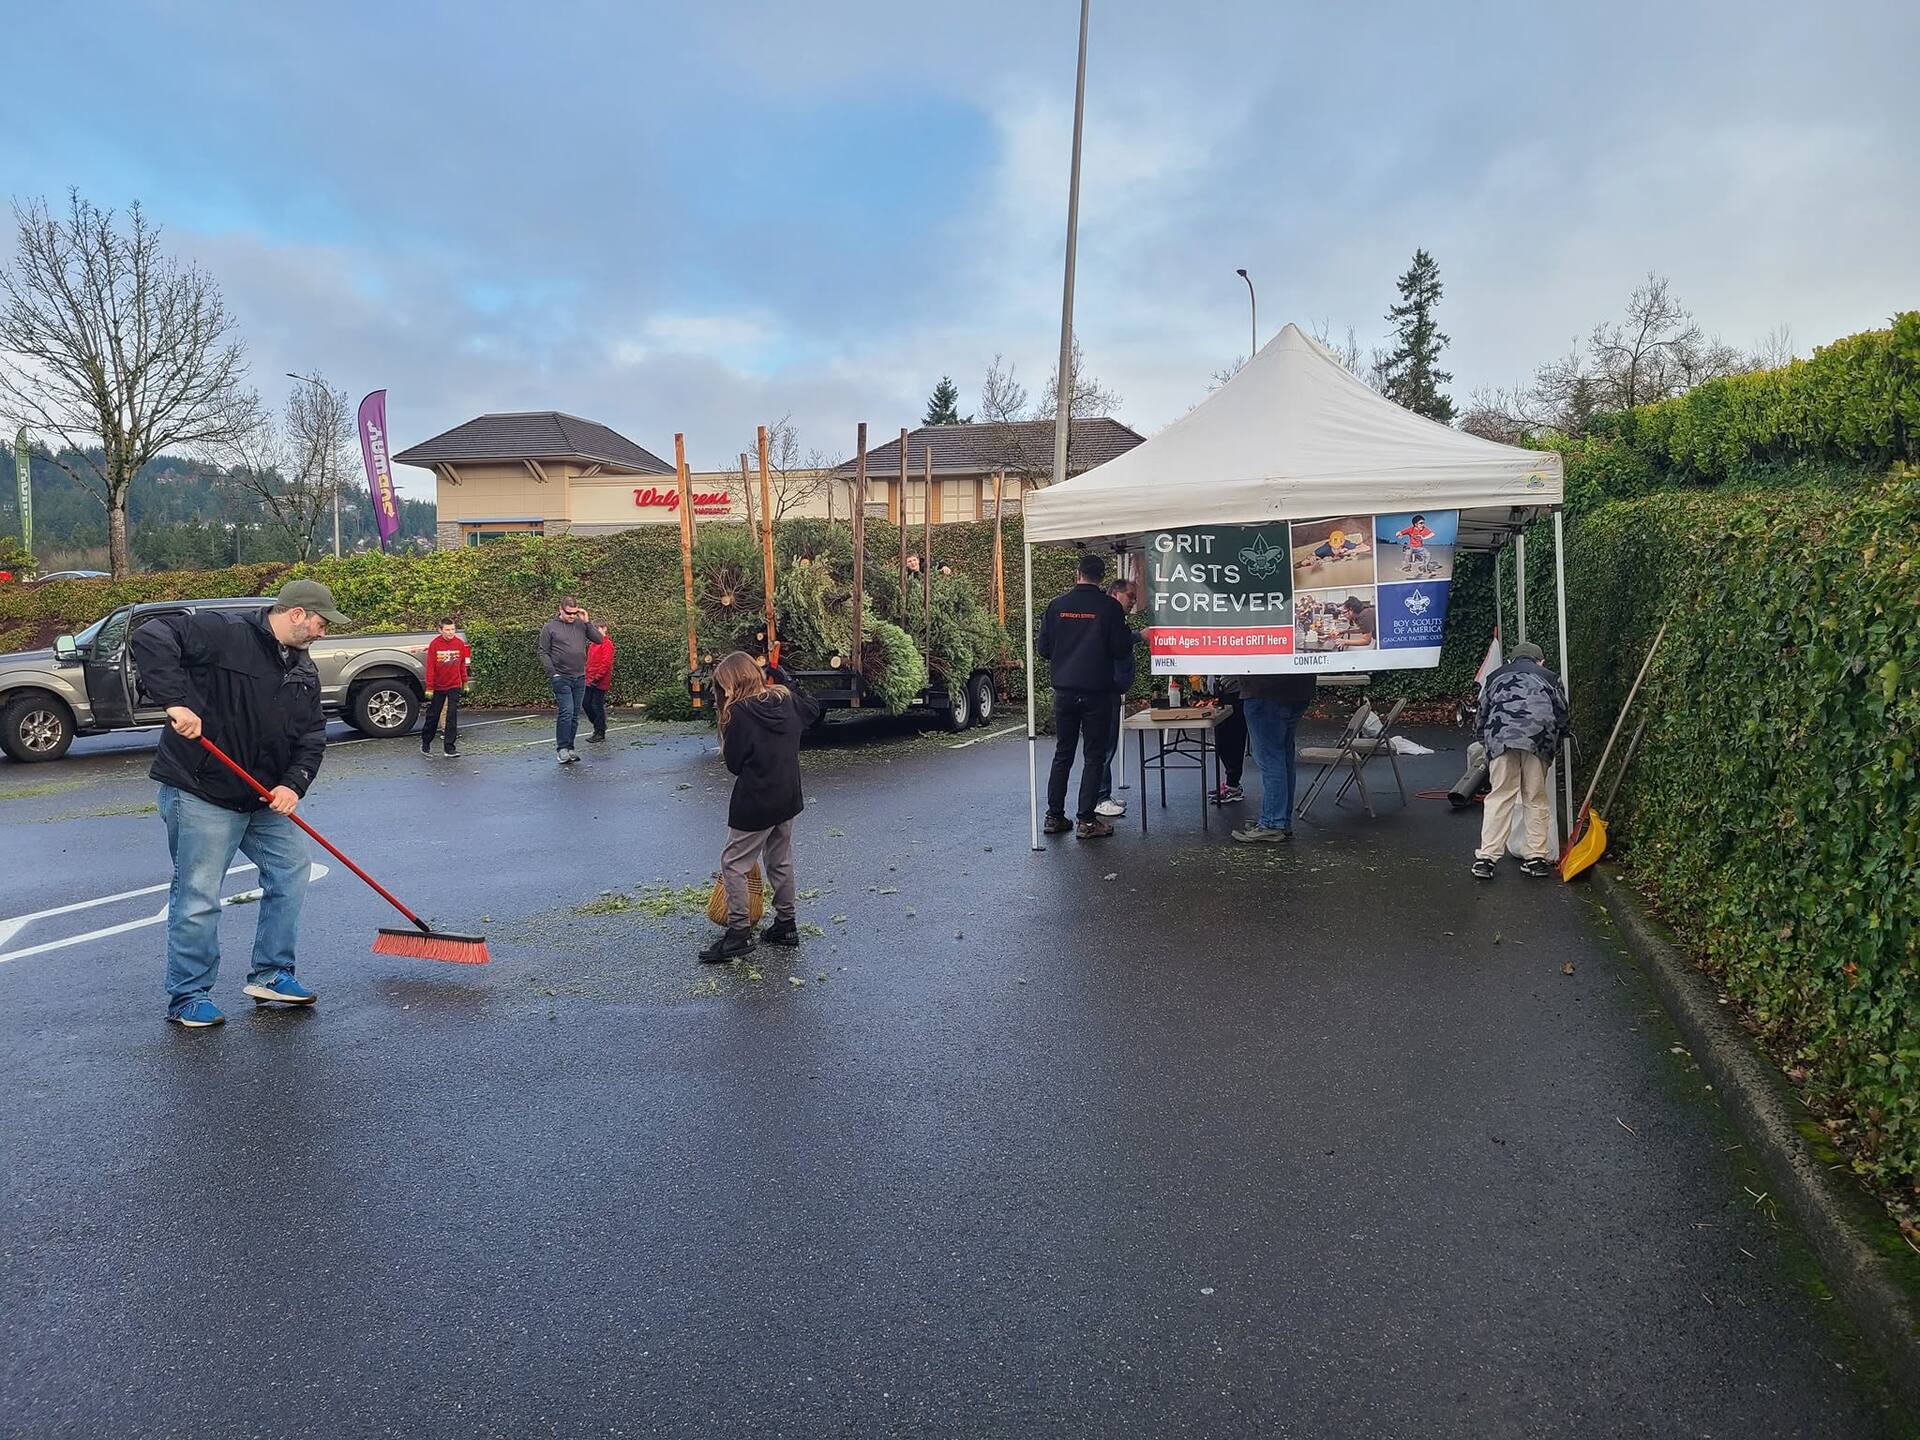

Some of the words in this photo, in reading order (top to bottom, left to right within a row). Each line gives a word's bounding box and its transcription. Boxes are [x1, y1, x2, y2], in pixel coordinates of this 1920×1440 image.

[366, 420, 395, 518] SUBWAY
[633, 487, 730, 511] Walgeens
[1154, 533, 1216, 554] GRIT
[1155, 563, 1240, 583] LASTS
[1154, 592, 1284, 612] FOREVER
[1412, 618, 1442, 626] SCOUTS
[1154, 635, 1177, 646] Youth
[1179, 636, 1200, 648] Ages
[1229, 635, 1244, 646] Get
[1245, 635, 1265, 646] GRIT
[1267, 634, 1288, 645] Here
[1154, 658, 1177, 667] WHEN:
[1293, 655, 1330, 666] CONTACT:
